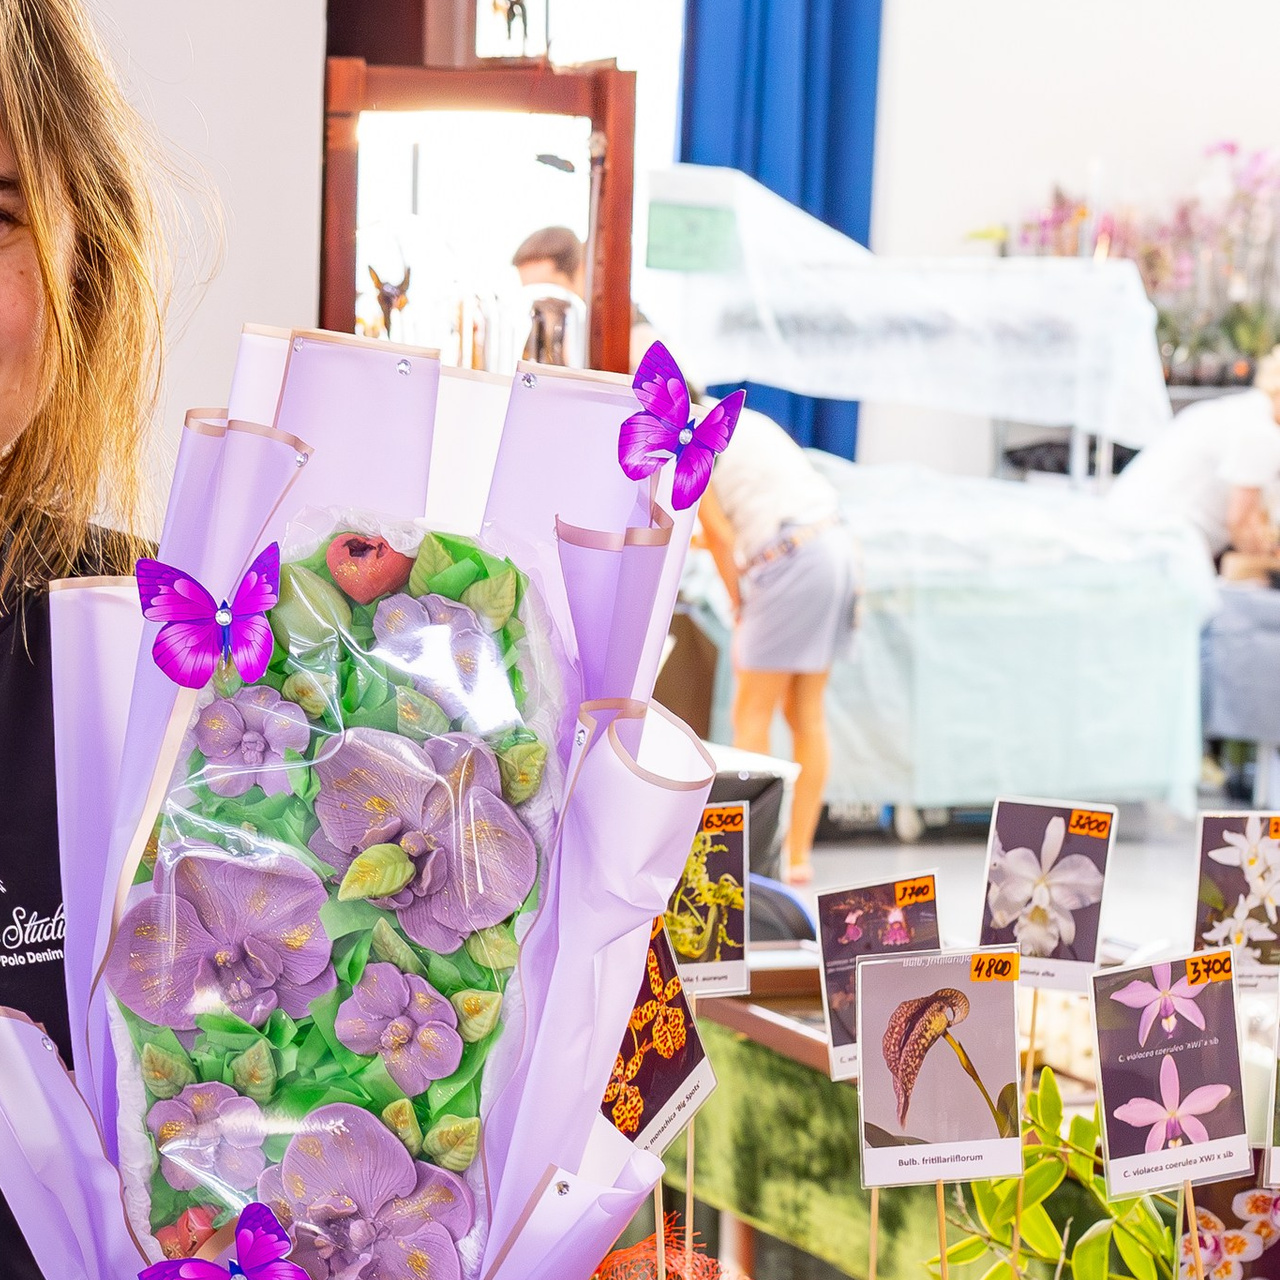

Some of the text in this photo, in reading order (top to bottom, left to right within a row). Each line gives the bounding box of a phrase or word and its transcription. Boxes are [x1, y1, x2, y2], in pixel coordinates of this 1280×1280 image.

[705, 813, 743, 829] 6300
[2, 902, 66, 949] Studi
[27, 948, 64, 964] Denim
[974, 958, 1012, 978] 4800
[1190, 957, 1232, 984] 3700
[650, 1111, 677, 1145] monachica
[898, 1154, 983, 1167] Bulb. fritillariiflorum
[1133, 1165, 1164, 1176] violacea
[1165, 1158, 1197, 1170] coerulea
[1223, 1150, 1234, 1158] sib
